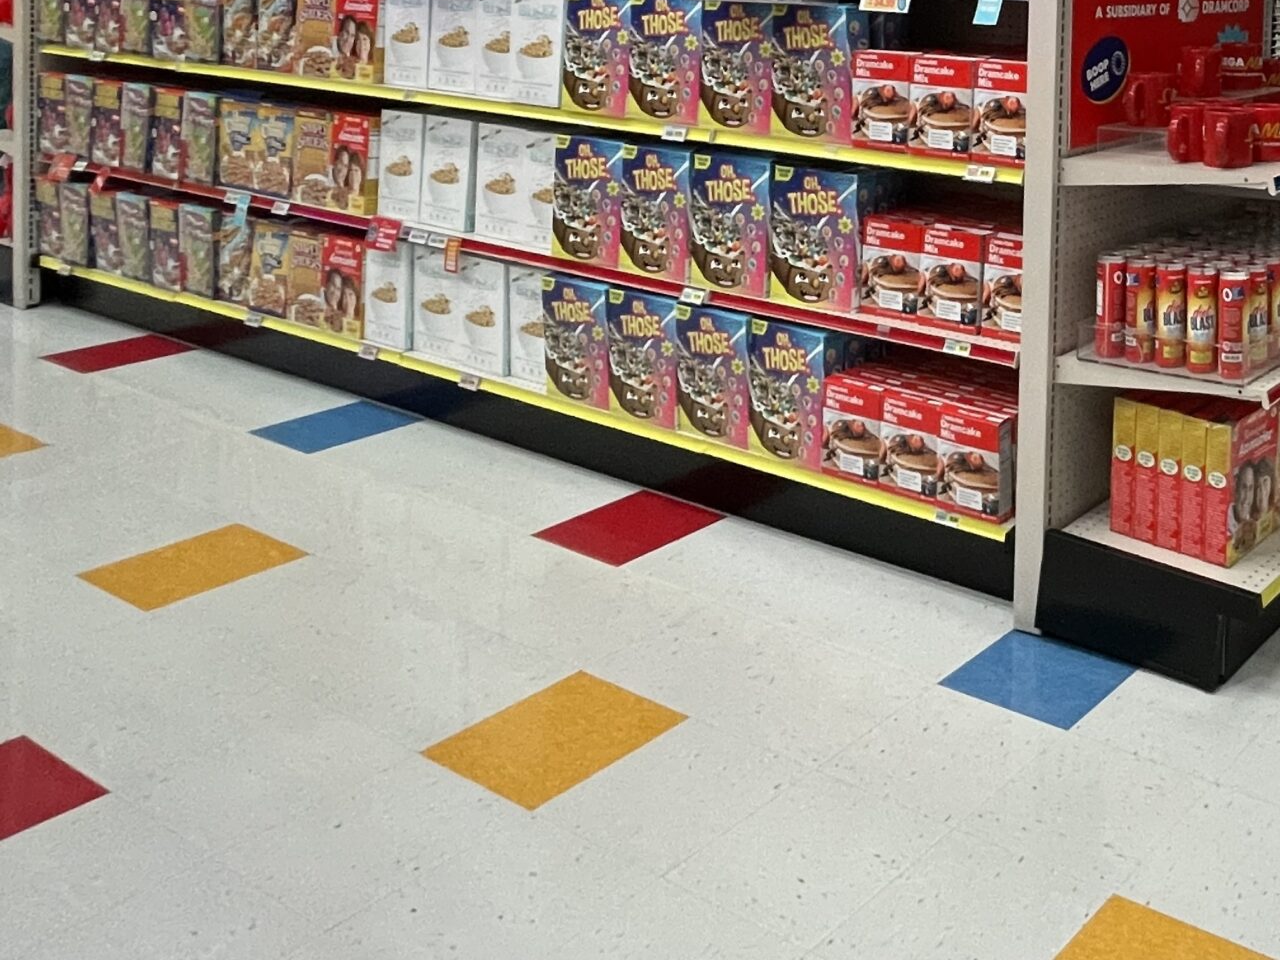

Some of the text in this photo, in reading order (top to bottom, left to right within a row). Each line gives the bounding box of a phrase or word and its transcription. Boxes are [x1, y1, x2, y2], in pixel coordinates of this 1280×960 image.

[1095, 0, 1250, 19] A SUBSIDIARY OF DRAMCORP
[856, 59, 894, 70] Dramcake
[913, 64, 955, 76] Dramcake
[856, 68, 870, 77] Mix
[979, 68, 1020, 81] Dramcake
[913, 73, 929, 84] Mix
[978, 77, 993, 88] Mix
[867, 226, 905, 240] Dramcake
[867, 236, 880, 246] Mix
[925, 234, 965, 249] Dramcake
[925, 244, 939, 254] Mix
[988, 254, 1004, 265] Mix
[1190, 316, 1214, 331] BLAST
[826, 389, 864, 406] Dramcake
[826, 398, 840, 409] Mix
[883, 402, 923, 420] Dramcake
[883, 412, 898, 423] Mix
[940, 419, 982, 438] Dramcake
[940, 430, 955, 441] Mix
